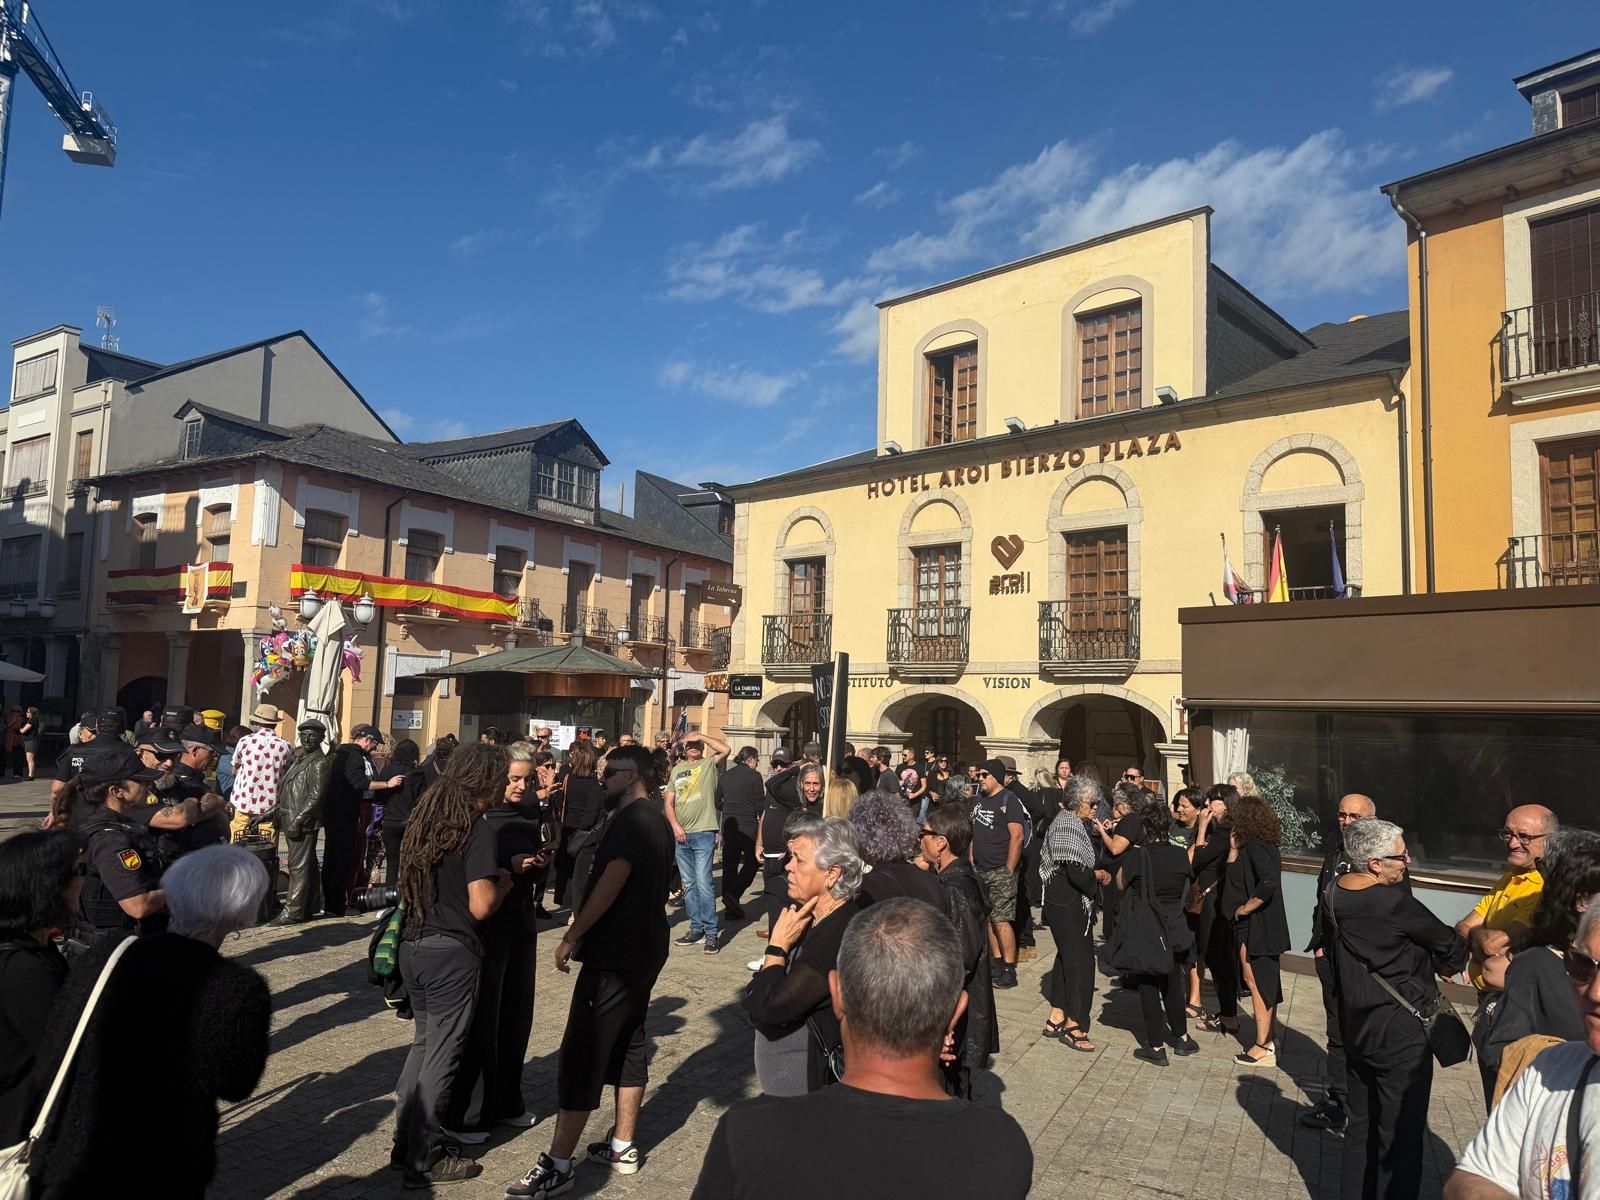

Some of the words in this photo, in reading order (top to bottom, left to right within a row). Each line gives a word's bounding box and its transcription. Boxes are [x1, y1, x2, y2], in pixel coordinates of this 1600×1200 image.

[867, 472, 930, 499] HOTEL
[938, 464, 990, 489] AROI
[1001, 446, 1086, 480] BIERZO
[1099, 429, 1182, 464] PLAZA
[983, 677, 1031, 689] VISION
